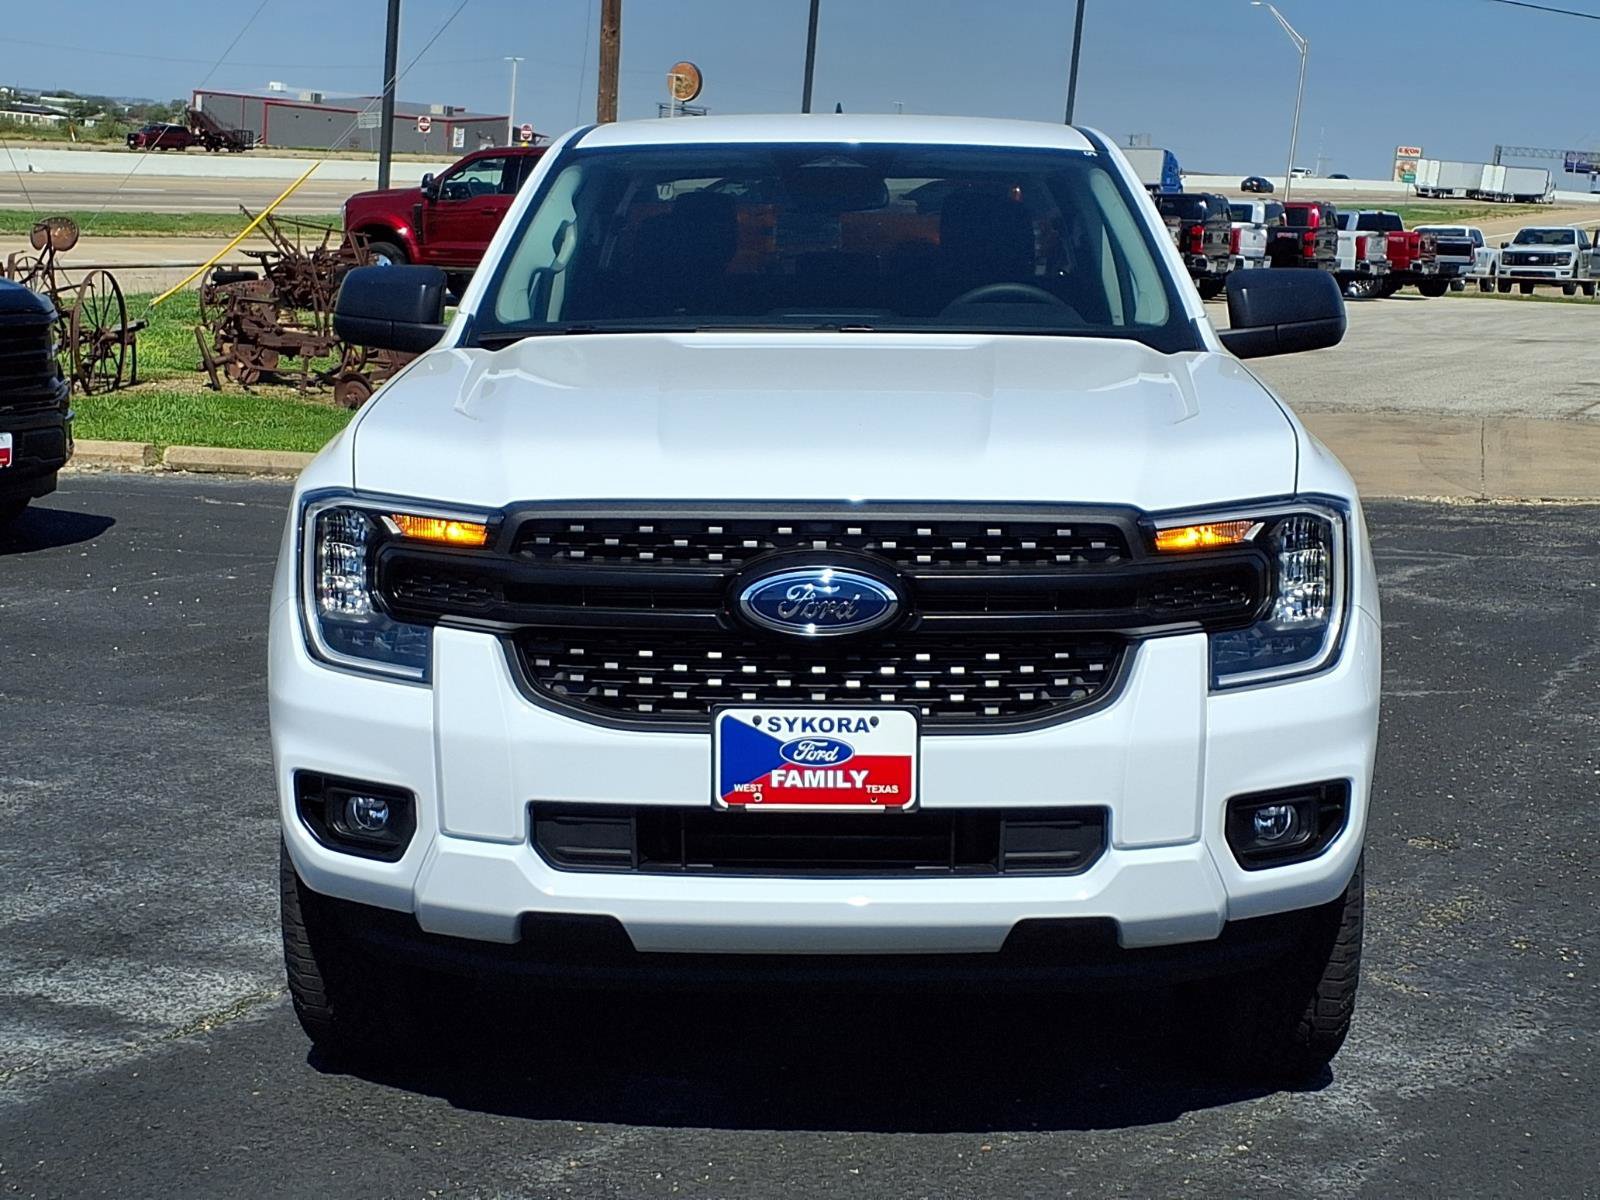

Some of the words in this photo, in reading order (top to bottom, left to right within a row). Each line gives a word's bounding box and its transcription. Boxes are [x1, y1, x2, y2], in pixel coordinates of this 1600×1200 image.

[778, 583, 862, 620] Ford
[767, 716, 870, 733] SYKORA
[793, 740, 839, 762] Ford
[770, 769, 869, 788] FAMILY
[734, 784, 763, 793] WEST
[866, 784, 899, 794] TEXAS
